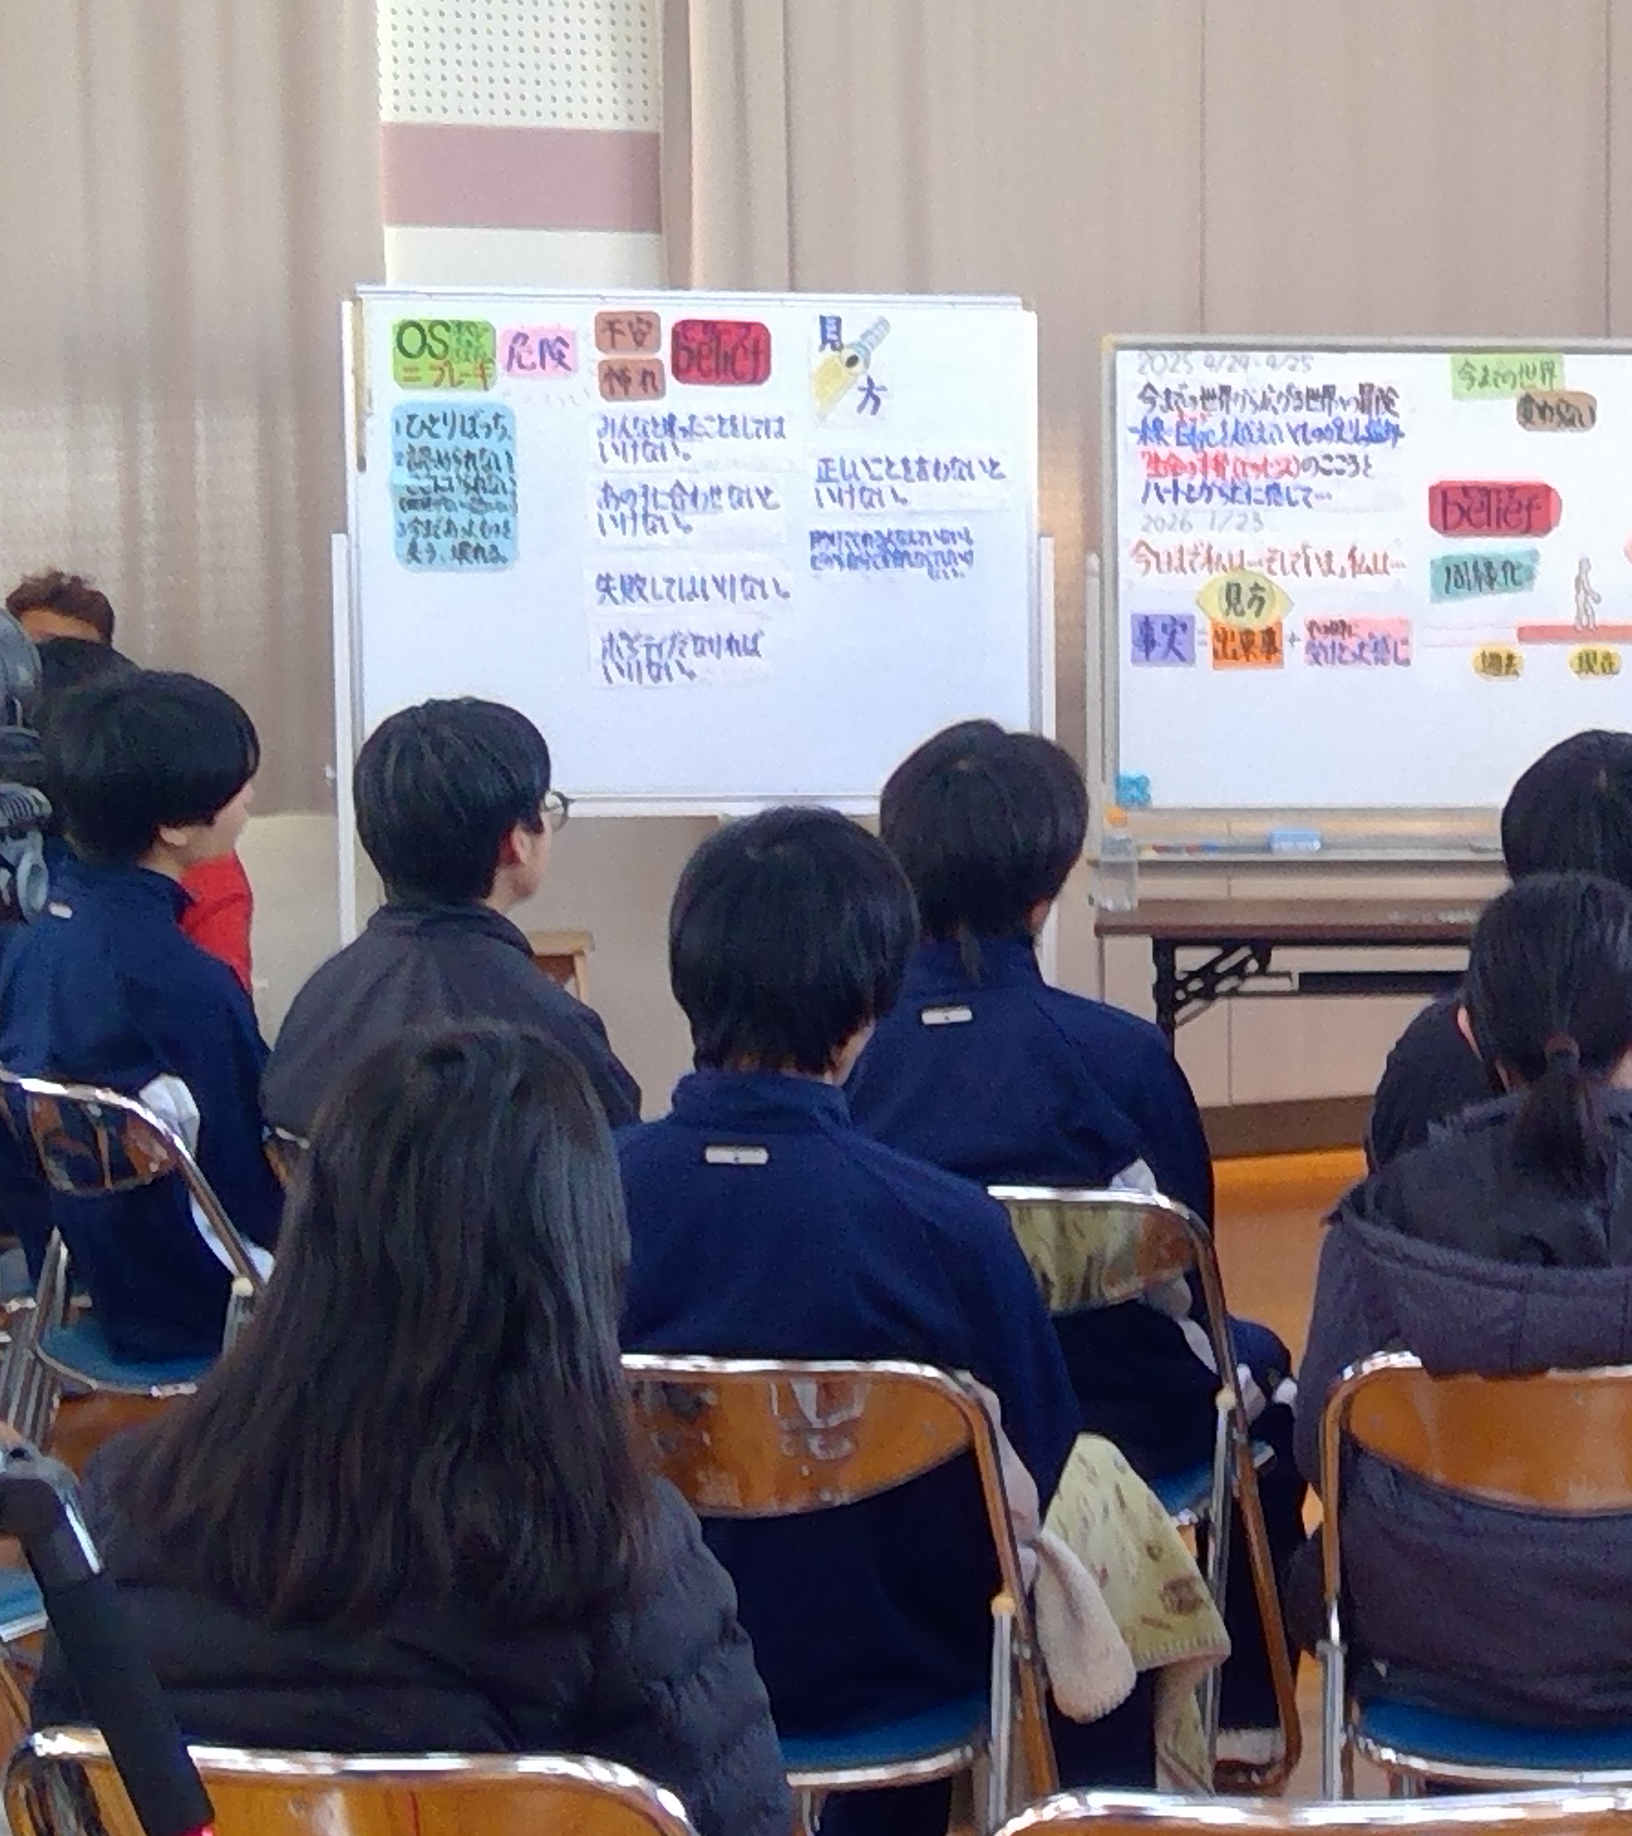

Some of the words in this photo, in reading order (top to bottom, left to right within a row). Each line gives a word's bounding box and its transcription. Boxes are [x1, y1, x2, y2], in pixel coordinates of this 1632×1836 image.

[395, 319, 451, 360] OS
[601, 315, 654, 349] 不安
[506, 331, 573, 373] 危険
[1137, 351, 1194, 375] 2025
[1141, 508, 1194, 534] 2026
[1441, 486, 1542, 533] belief
[1225, 580, 1267, 618] 見方
[1138, 614, 1188, 662] 事実
